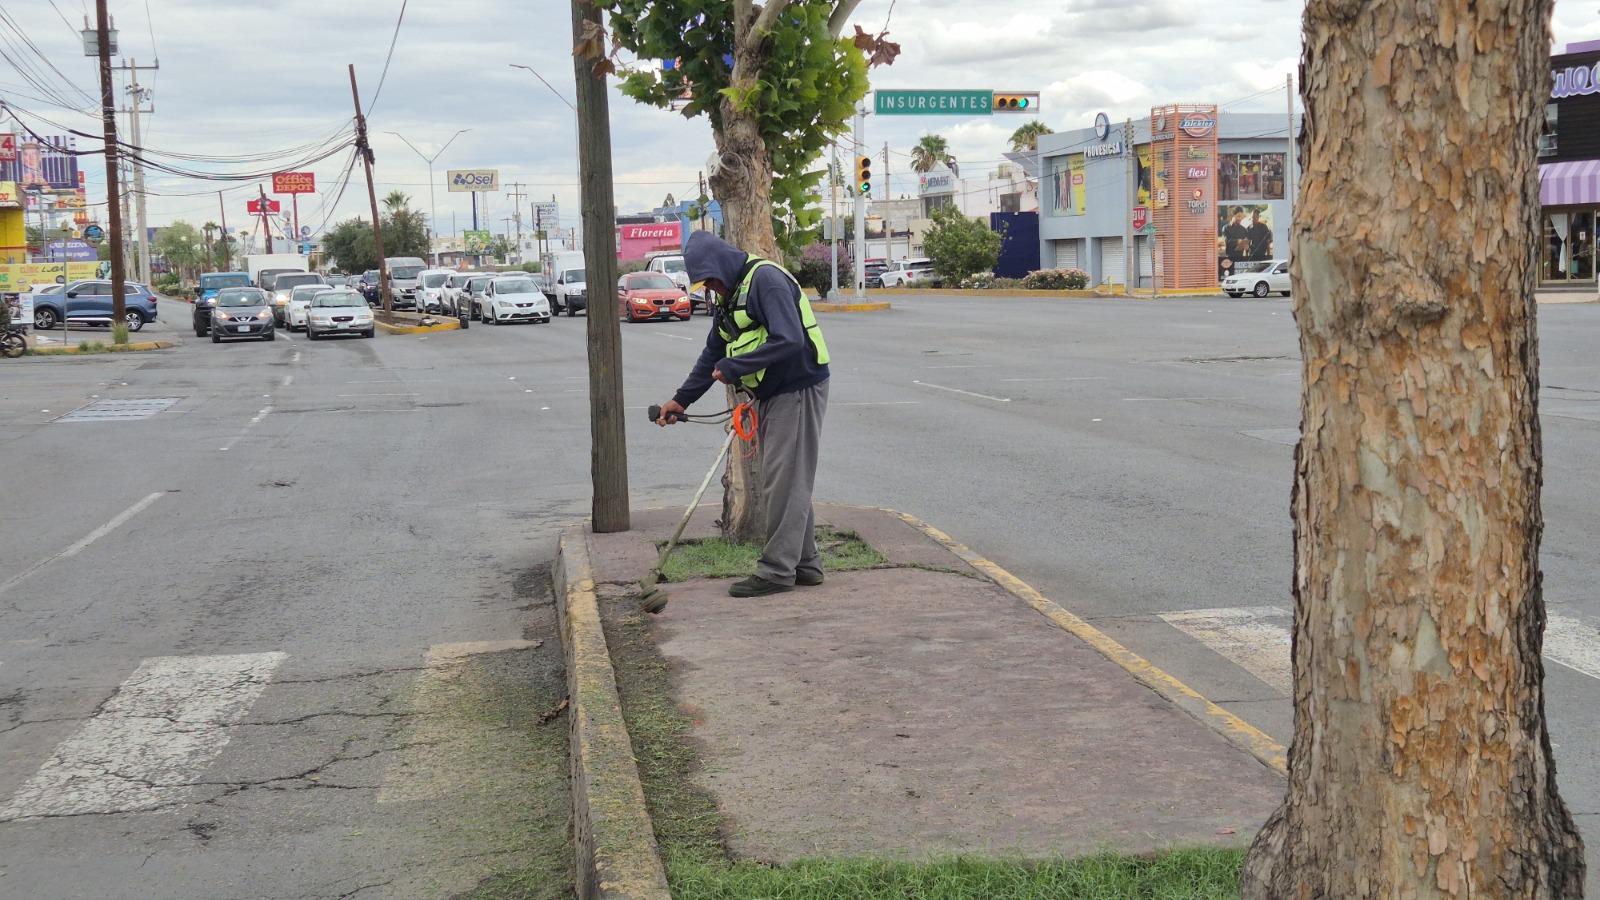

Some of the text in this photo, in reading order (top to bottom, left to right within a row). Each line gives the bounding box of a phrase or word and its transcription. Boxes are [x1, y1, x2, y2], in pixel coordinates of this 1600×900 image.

[880, 96, 988, 109] INSURGENTES
[1188, 166, 1208, 178] flexi
[275, 174, 312, 184] Office
[465, 172, 494, 185] Osel
[276, 184, 313, 192] DEPOT
[630, 227, 674, 238] Floreria
